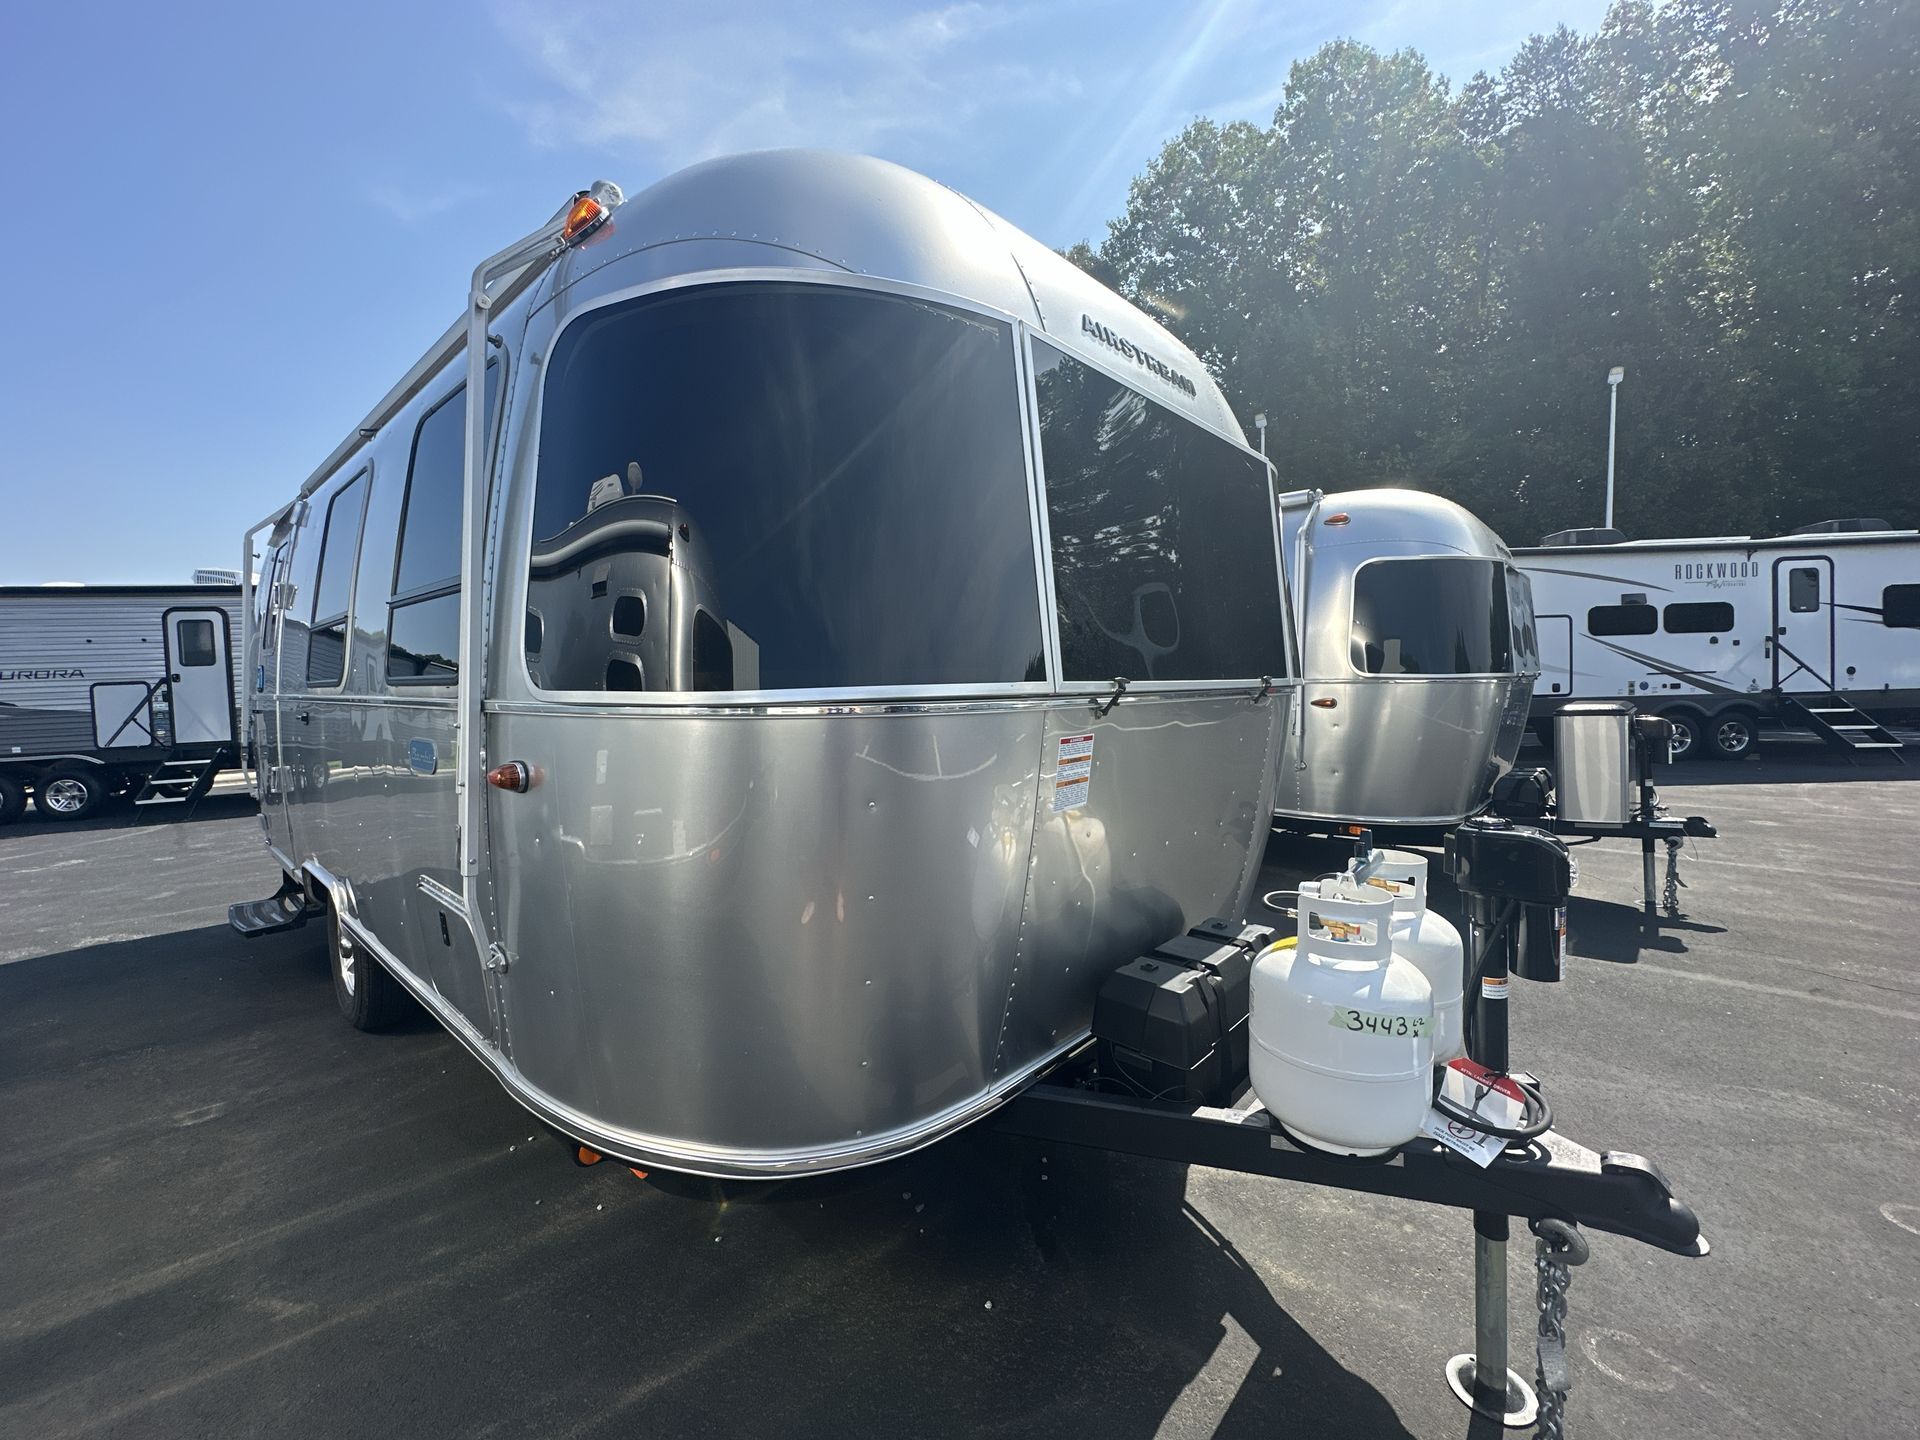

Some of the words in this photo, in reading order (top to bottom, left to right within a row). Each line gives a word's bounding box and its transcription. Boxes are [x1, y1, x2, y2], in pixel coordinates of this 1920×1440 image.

[1082, 313, 1197, 397] AIRSTREAM
[1675, 561, 1759, 580] ROCKWOOD
[1347, 1010, 1408, 1036] 3443
[1493, 1083, 1511, 1095] DRIVER
